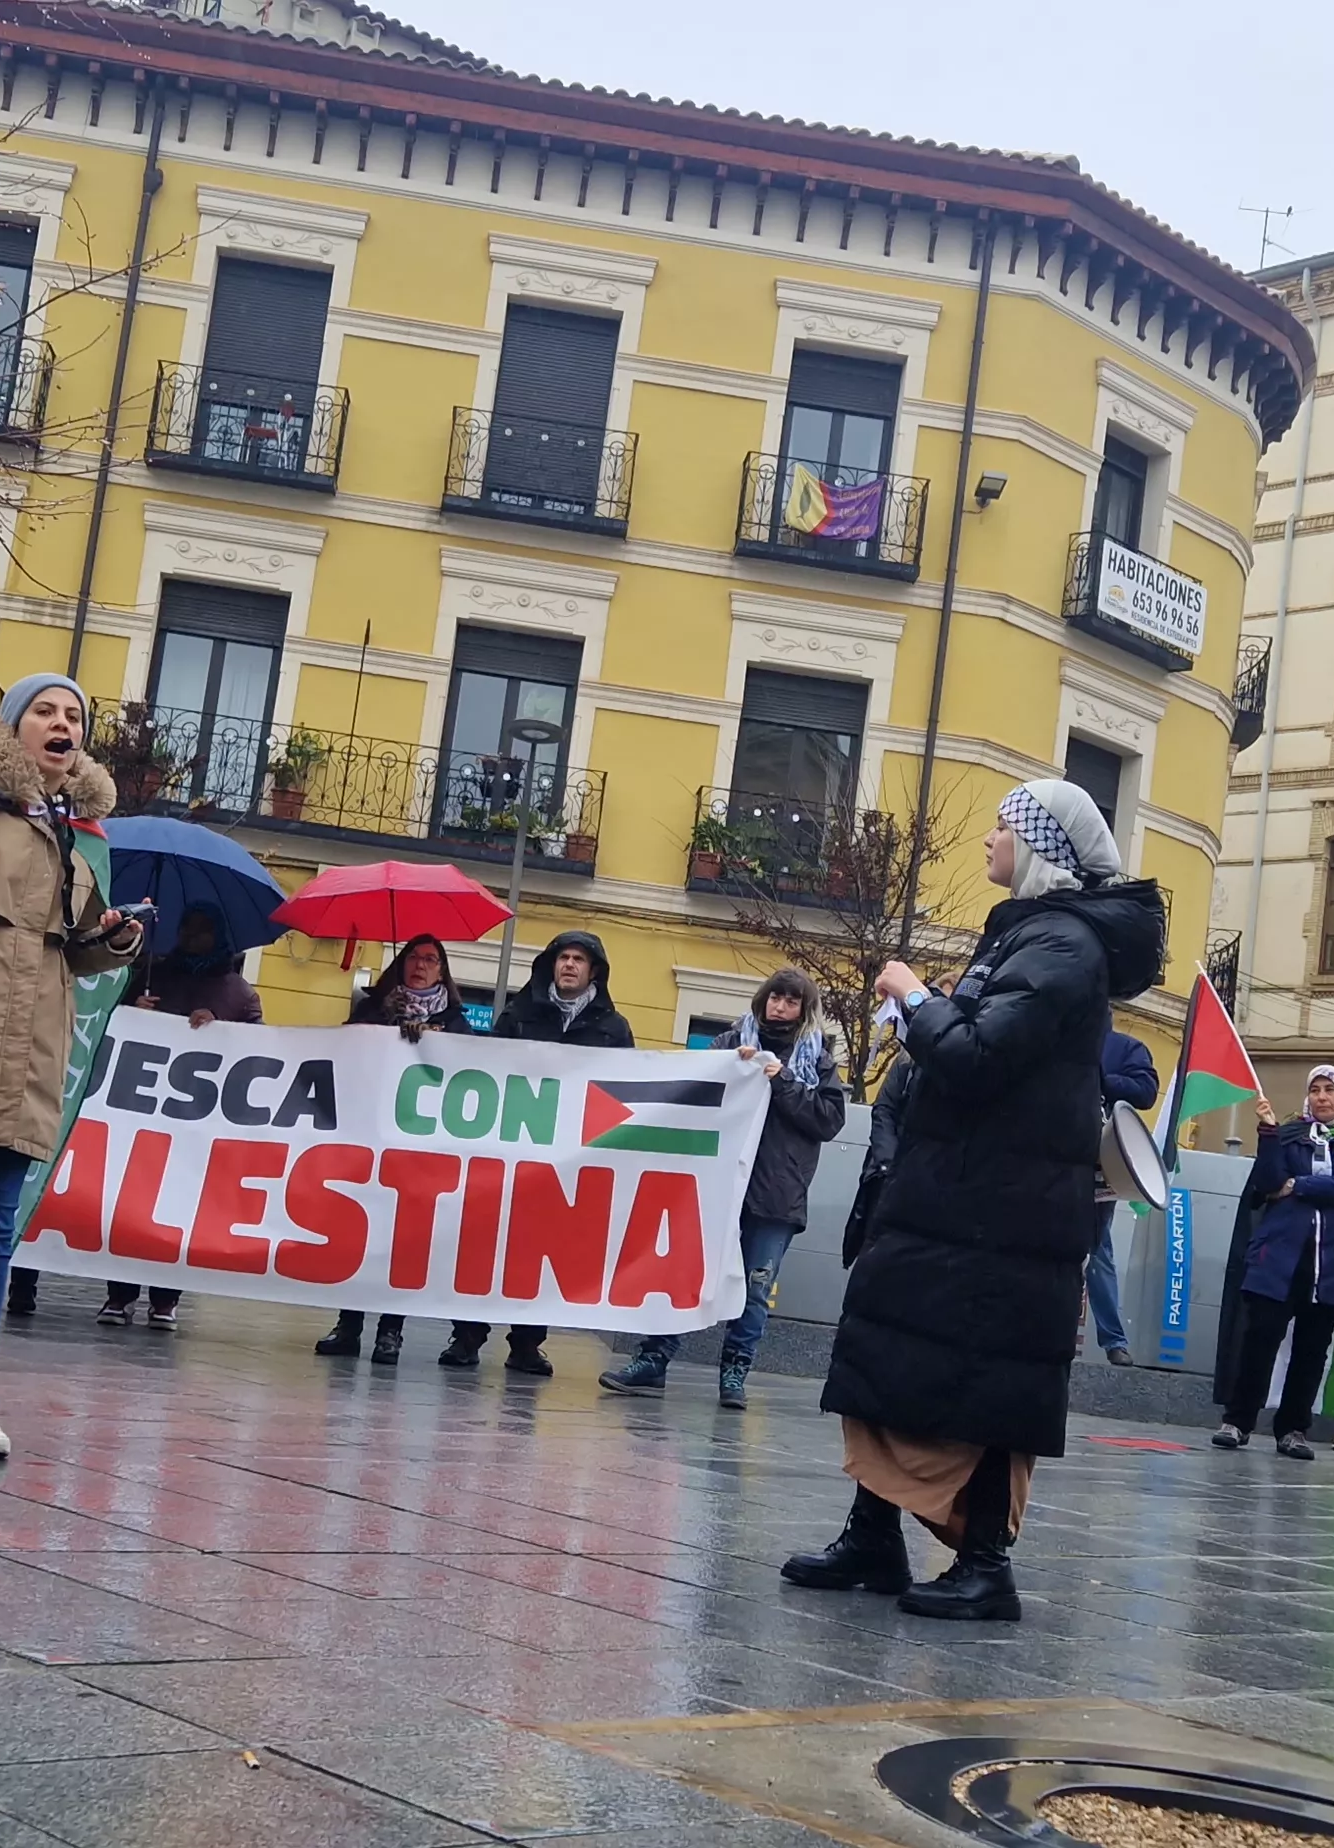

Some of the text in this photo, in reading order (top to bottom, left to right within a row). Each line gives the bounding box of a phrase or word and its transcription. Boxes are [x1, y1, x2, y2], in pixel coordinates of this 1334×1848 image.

[1107, 548, 1202, 613] HABITACIONES
[1132, 590, 1153, 615] 653
[1155, 600, 1168, 622] 96
[1171, 608, 1184, 630] 96
[1186, 616, 1199, 637] 56
[1131, 610, 1159, 630] RESIDENCIA
[1166, 628, 1198, 649] ESTUDIANTES
[394, 1063, 560, 1146] CON
[21, 1116, 706, 1310] ALESTINA
[1168, 1192, 1185, 1326] PAPEL-CARTÓN
